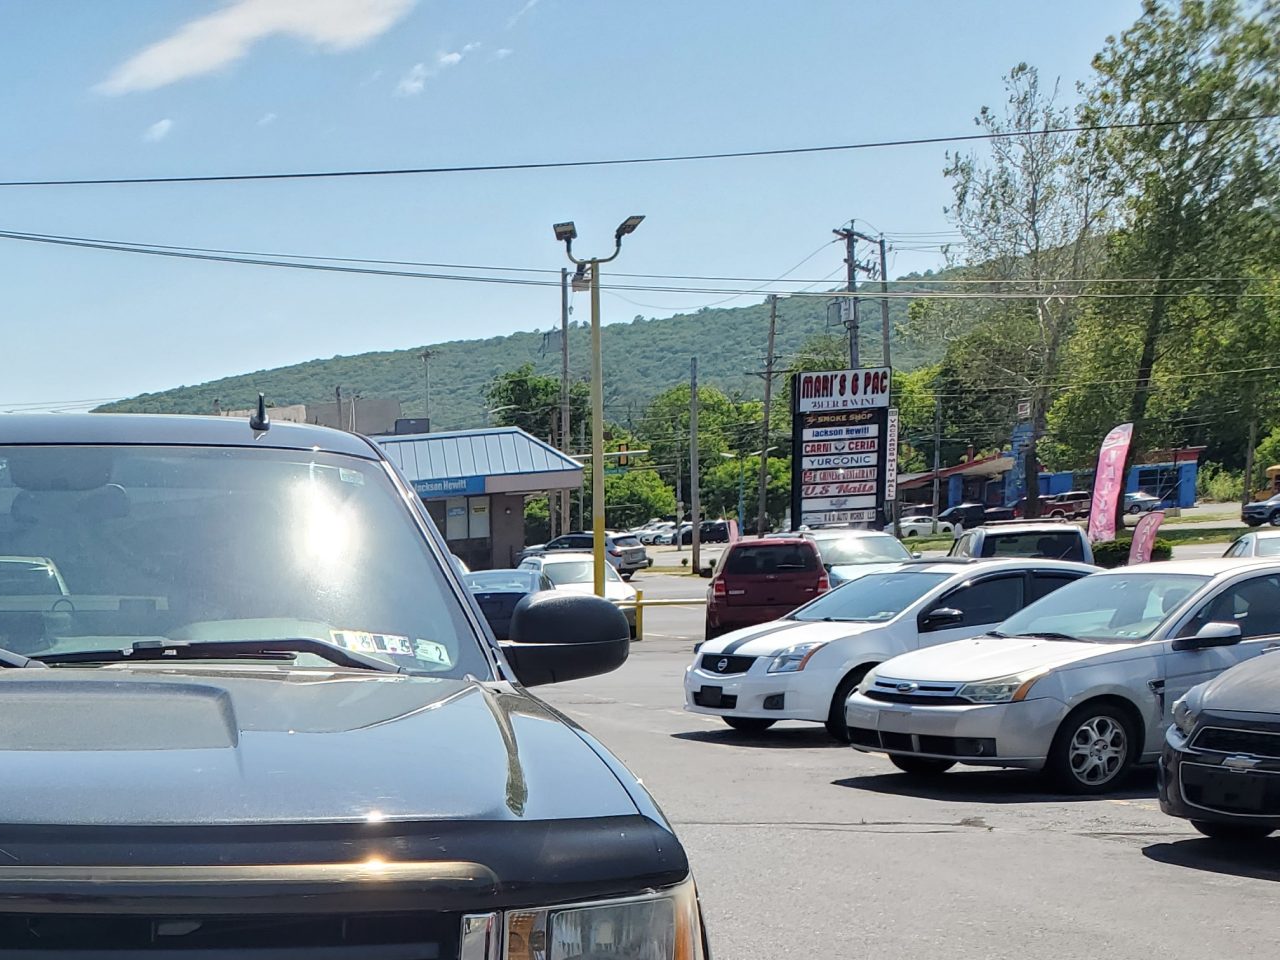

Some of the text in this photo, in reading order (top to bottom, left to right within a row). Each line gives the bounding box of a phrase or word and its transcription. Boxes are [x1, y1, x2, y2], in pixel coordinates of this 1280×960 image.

[864, 370, 888, 395] PAC
[849, 412, 873, 422] SHOP
[812, 426, 869, 438] Jackson Hewitt
[804, 440, 875, 453] CARNI CERIA
[809, 456, 871, 466] YURCONIC
[1135, 516, 1155, 563] NAILS
